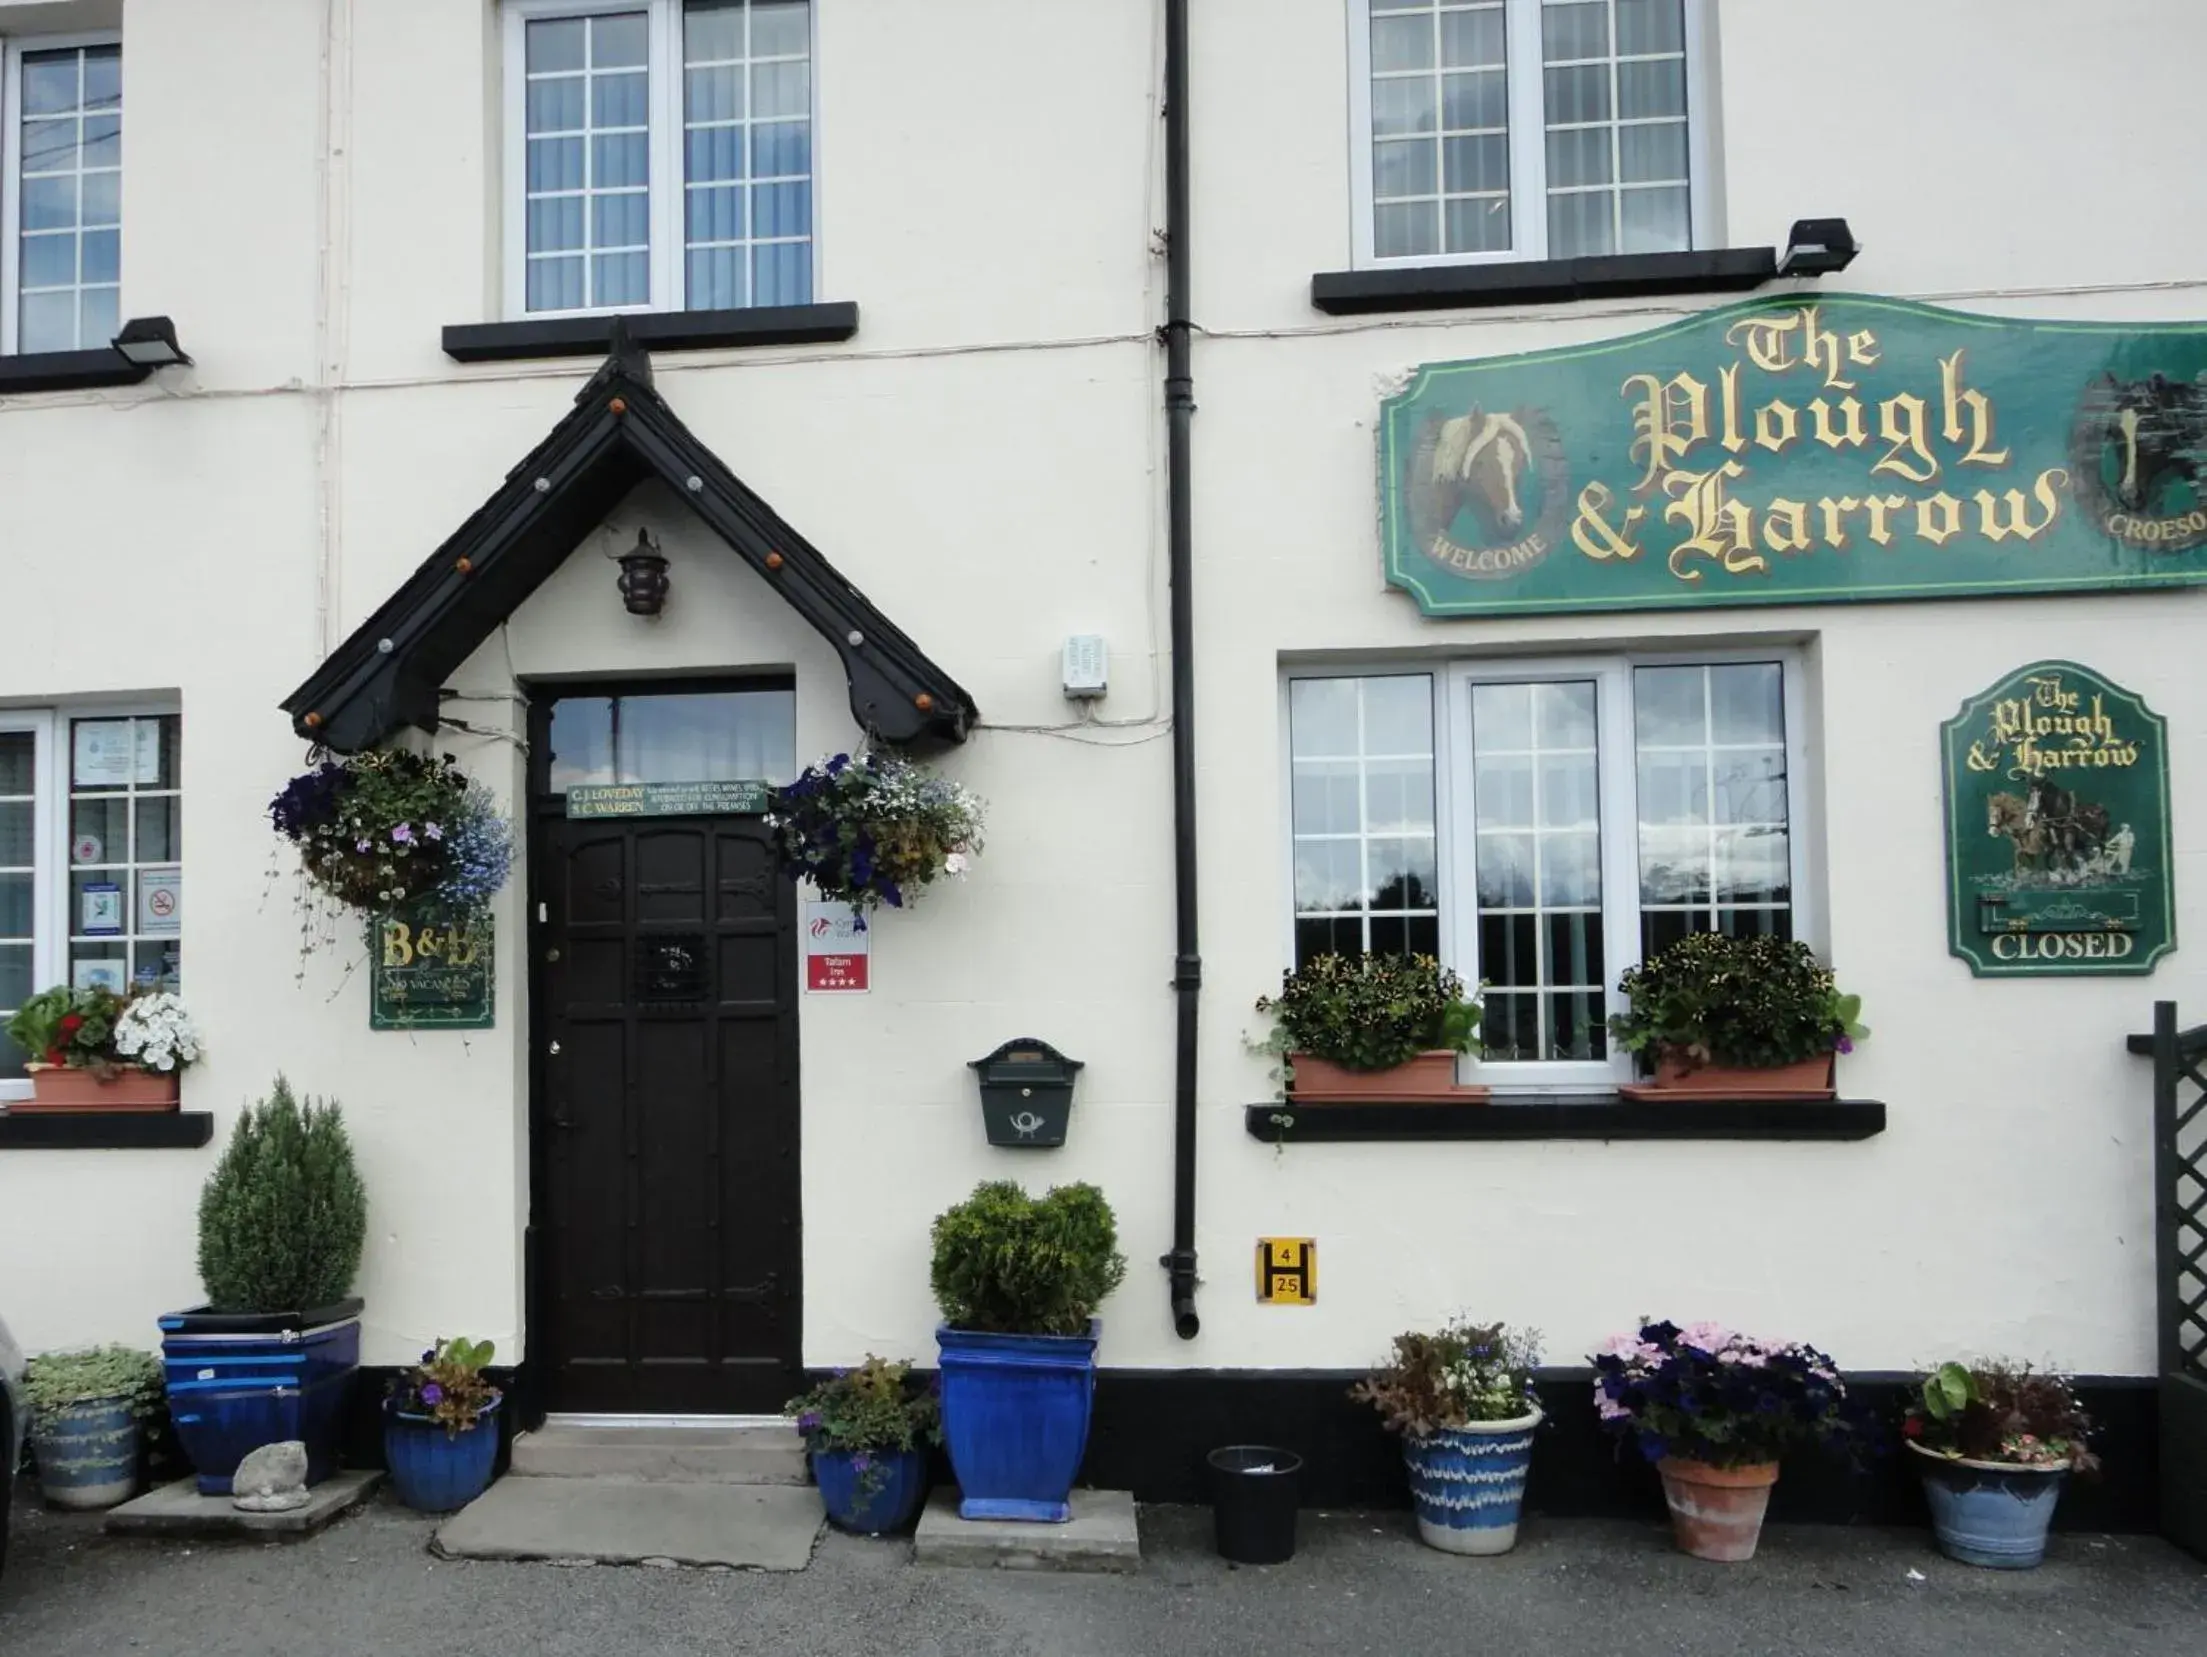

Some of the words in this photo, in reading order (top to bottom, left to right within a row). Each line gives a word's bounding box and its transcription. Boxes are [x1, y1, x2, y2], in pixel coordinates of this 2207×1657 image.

[1726, 306, 1880, 388] The
[1621, 347, 2009, 491] Plough
[1569, 479, 1648, 560] &
[1662, 464, 2069, 580] Harrow
[2107, 511, 2206, 541] CROESO
[1430, 533, 1549, 571] WELCOME
[2024, 673, 2080, 714] The
[1985, 693, 2121, 748] Plough
[1967, 739, 2000, 771] &
[2006, 736, 2146, 781] Harrow
[1992, 932, 2132, 960] CLOSED
[1264, 1243, 1308, 1298] H
[1281, 1249, 1291, 1262] 4
[1278, 1278, 1297, 1293] 25
